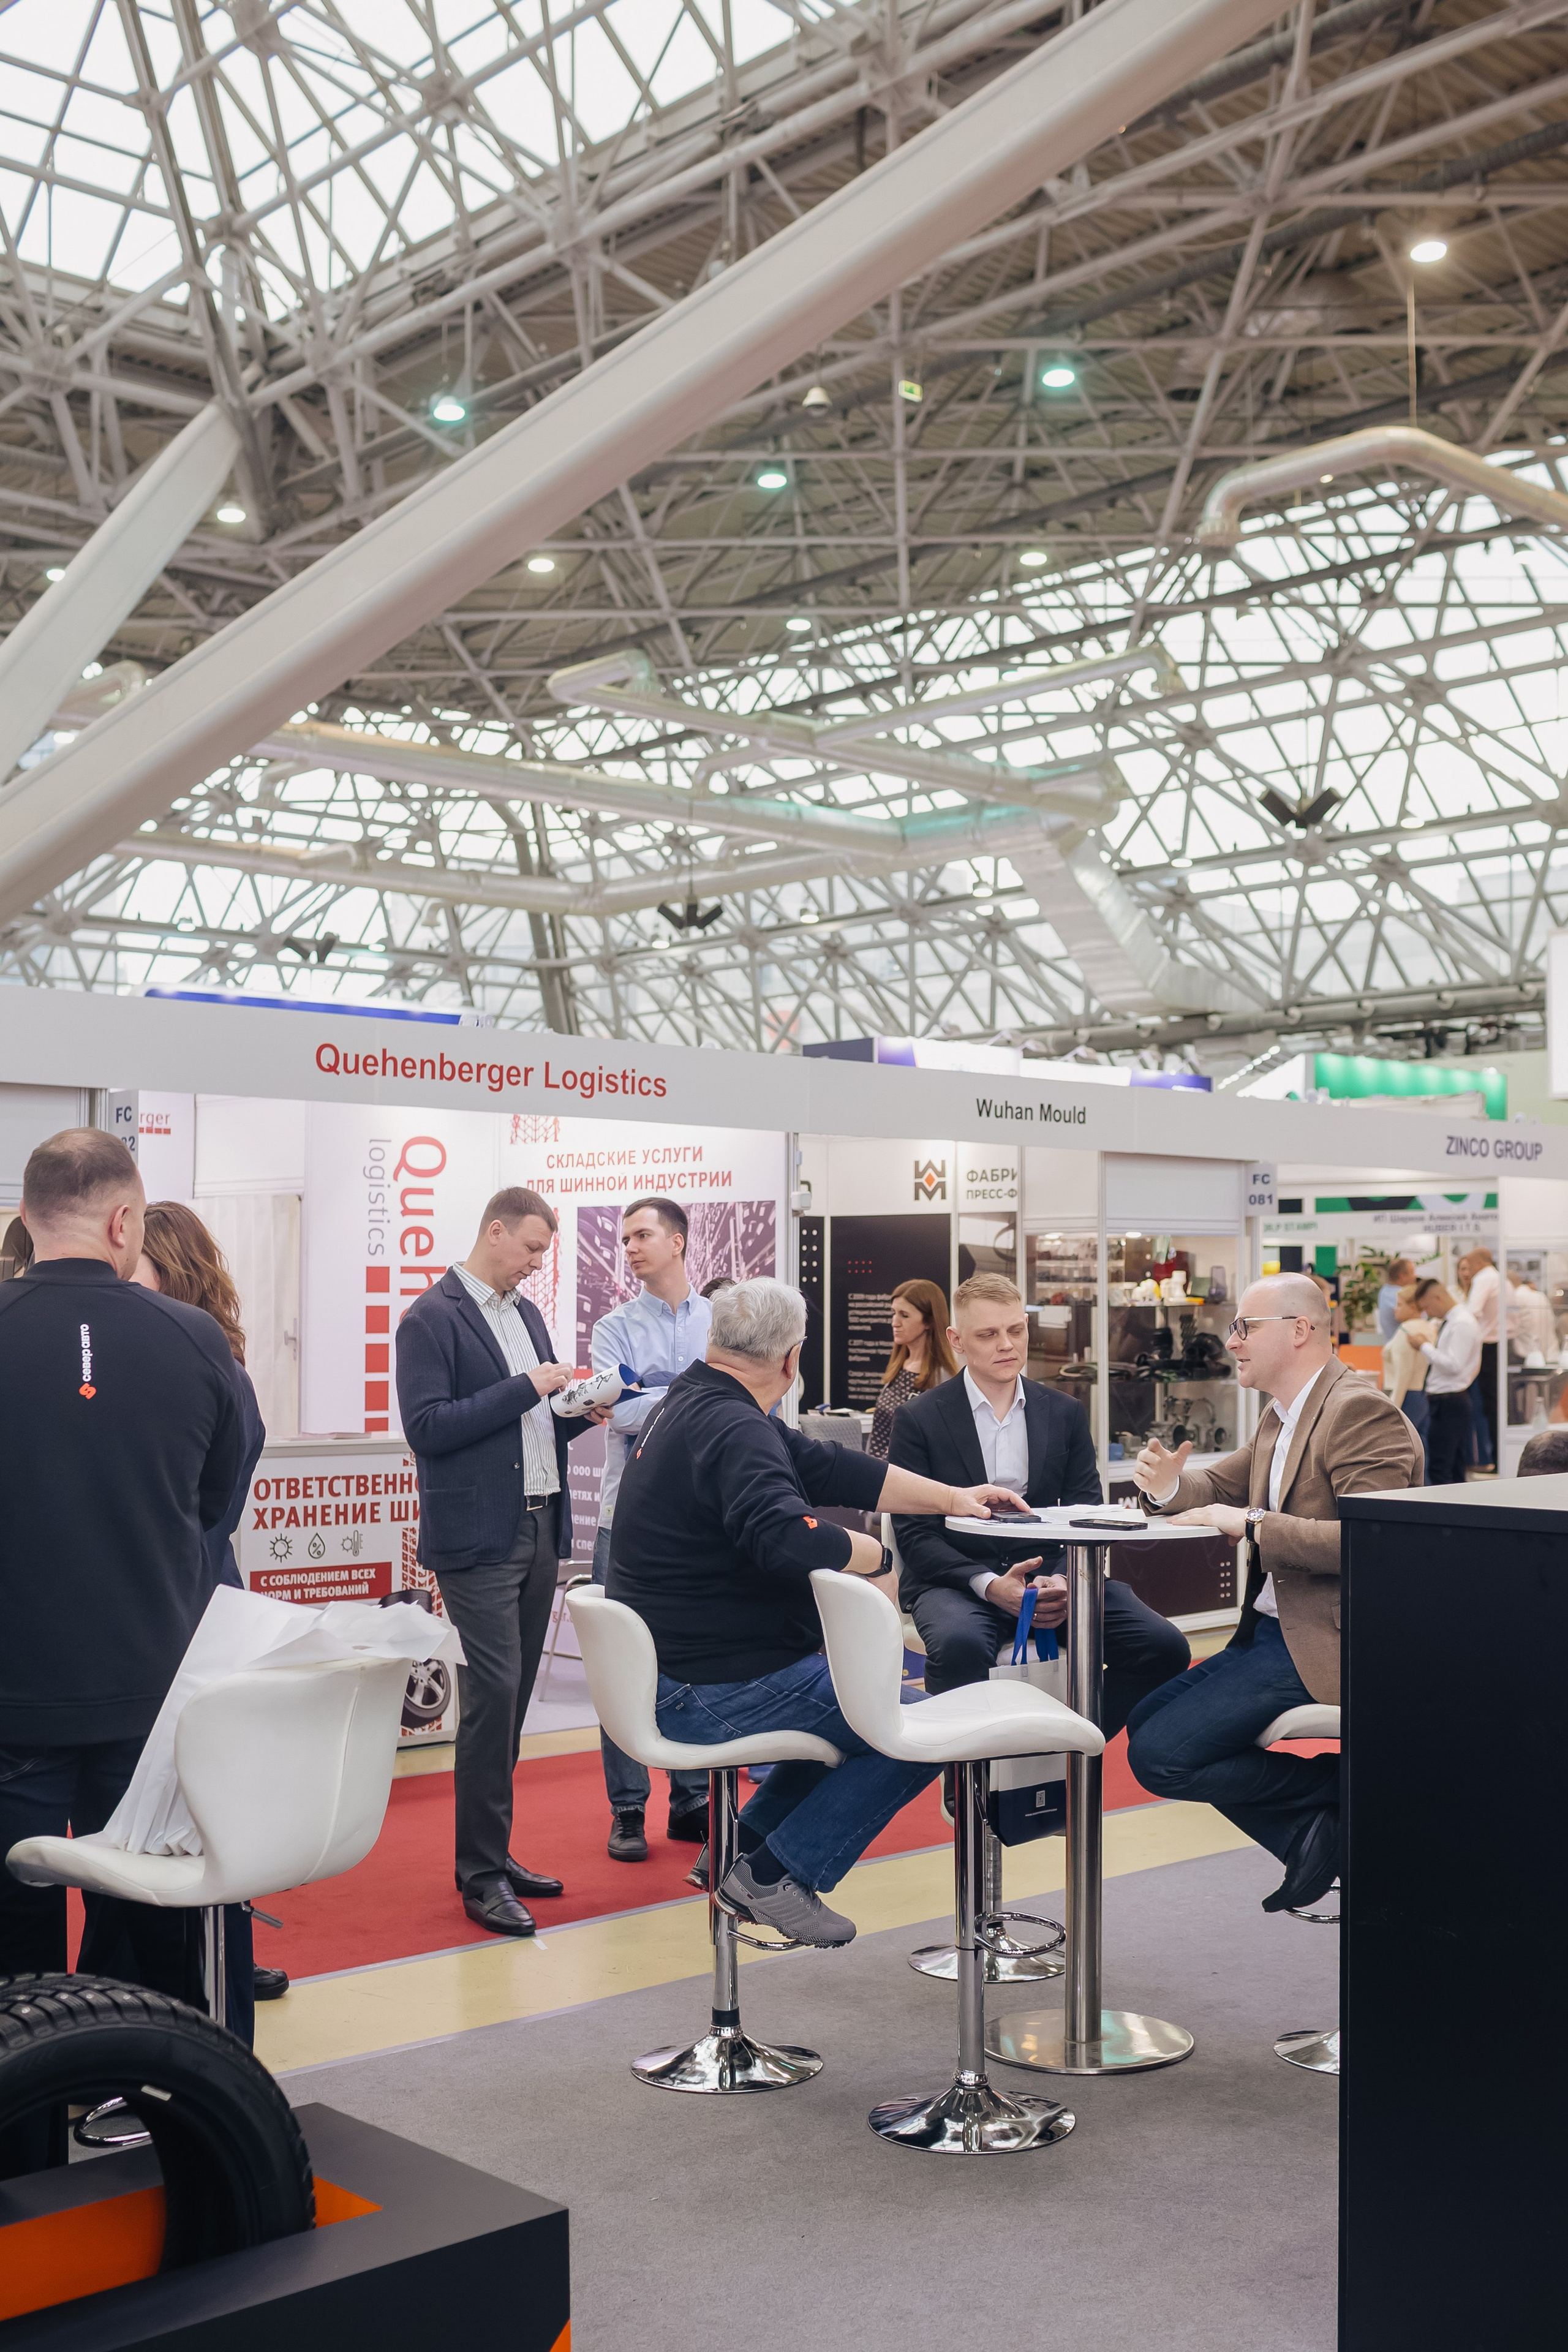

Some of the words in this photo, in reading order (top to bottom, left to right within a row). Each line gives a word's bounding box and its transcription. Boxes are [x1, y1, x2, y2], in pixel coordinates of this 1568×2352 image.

[315, 1043, 534, 1092] Quehenberger
[545, 1061, 667, 1099] Logistics
[115, 1106, 132, 1124] FC
[976, 1098, 1033, 1121] Wuhan
[1039, 1103, 1087, 1125] Mould
[546, 1150, 636, 1170] СКЛАДСКИЕ
[643, 1145, 703, 1164] УСЛУГИ
[1446, 1135, 1489, 1158] ZINCO
[1494, 1139, 1544, 1161] GROUP
[560, 1172, 628, 1193] ШИННОЙ
[633, 1170, 732, 1193] ИНДУСТРИИ
[1252, 1173, 1271, 1185] FC
[363, 1139, 392, 1256] logistics
[1249, 1193, 1273, 1205] 081
[393, 1136, 447, 1324] Queh
[254, 1472, 420, 1501] ОТВЕТСТВЕНН
[252, 1501, 381, 1530] ХРАНЕНИЕ
[260, 1575, 268, 1587] С
[269, 1570, 349, 1586] СОБЛЮДЕНИЕМ
[351, 1568, 376, 1580] ВСЕХ
[293, 1588, 301, 1600] И
[303, 1581, 369, 1599] ТРЕБОВАНИЙ
